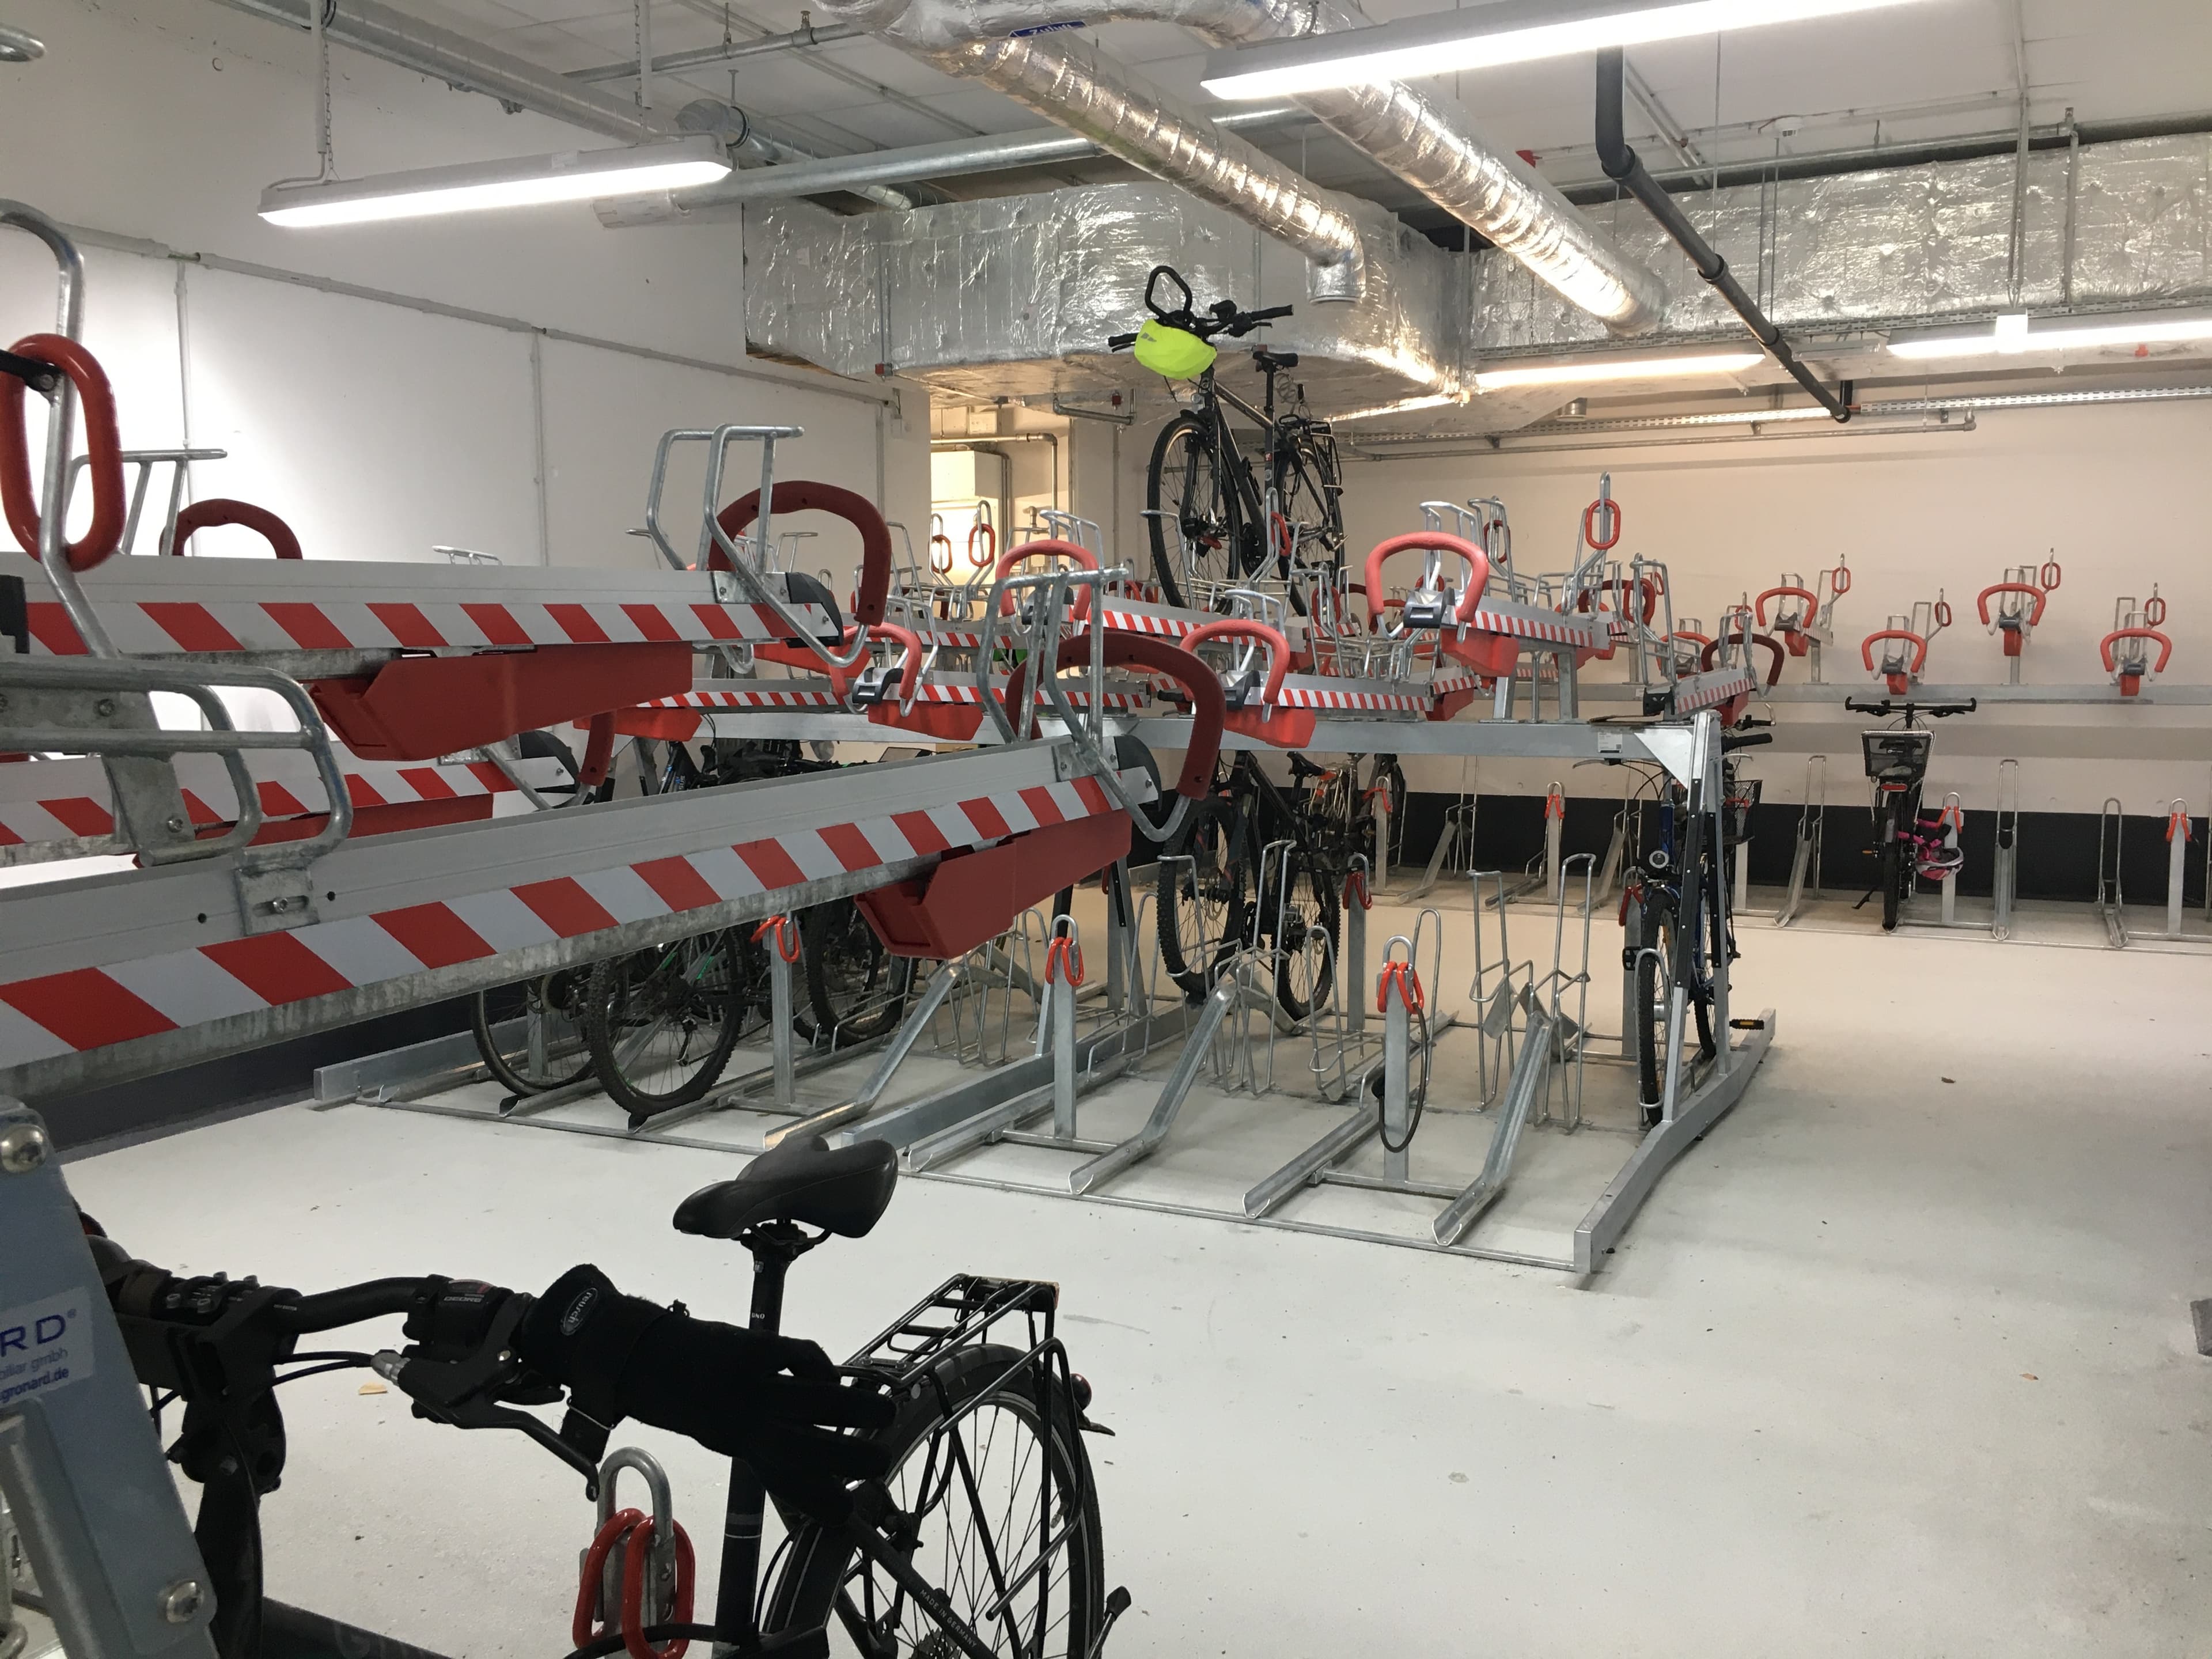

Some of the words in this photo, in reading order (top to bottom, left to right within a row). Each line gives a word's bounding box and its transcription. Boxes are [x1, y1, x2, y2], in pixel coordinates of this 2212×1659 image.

[567, 1291, 593, 1323] reusch
[31, 1347, 68, 1372] gmbh
[919, 1589, 939, 1609] MADE
[946, 1616, 977, 1647] GERMANY
